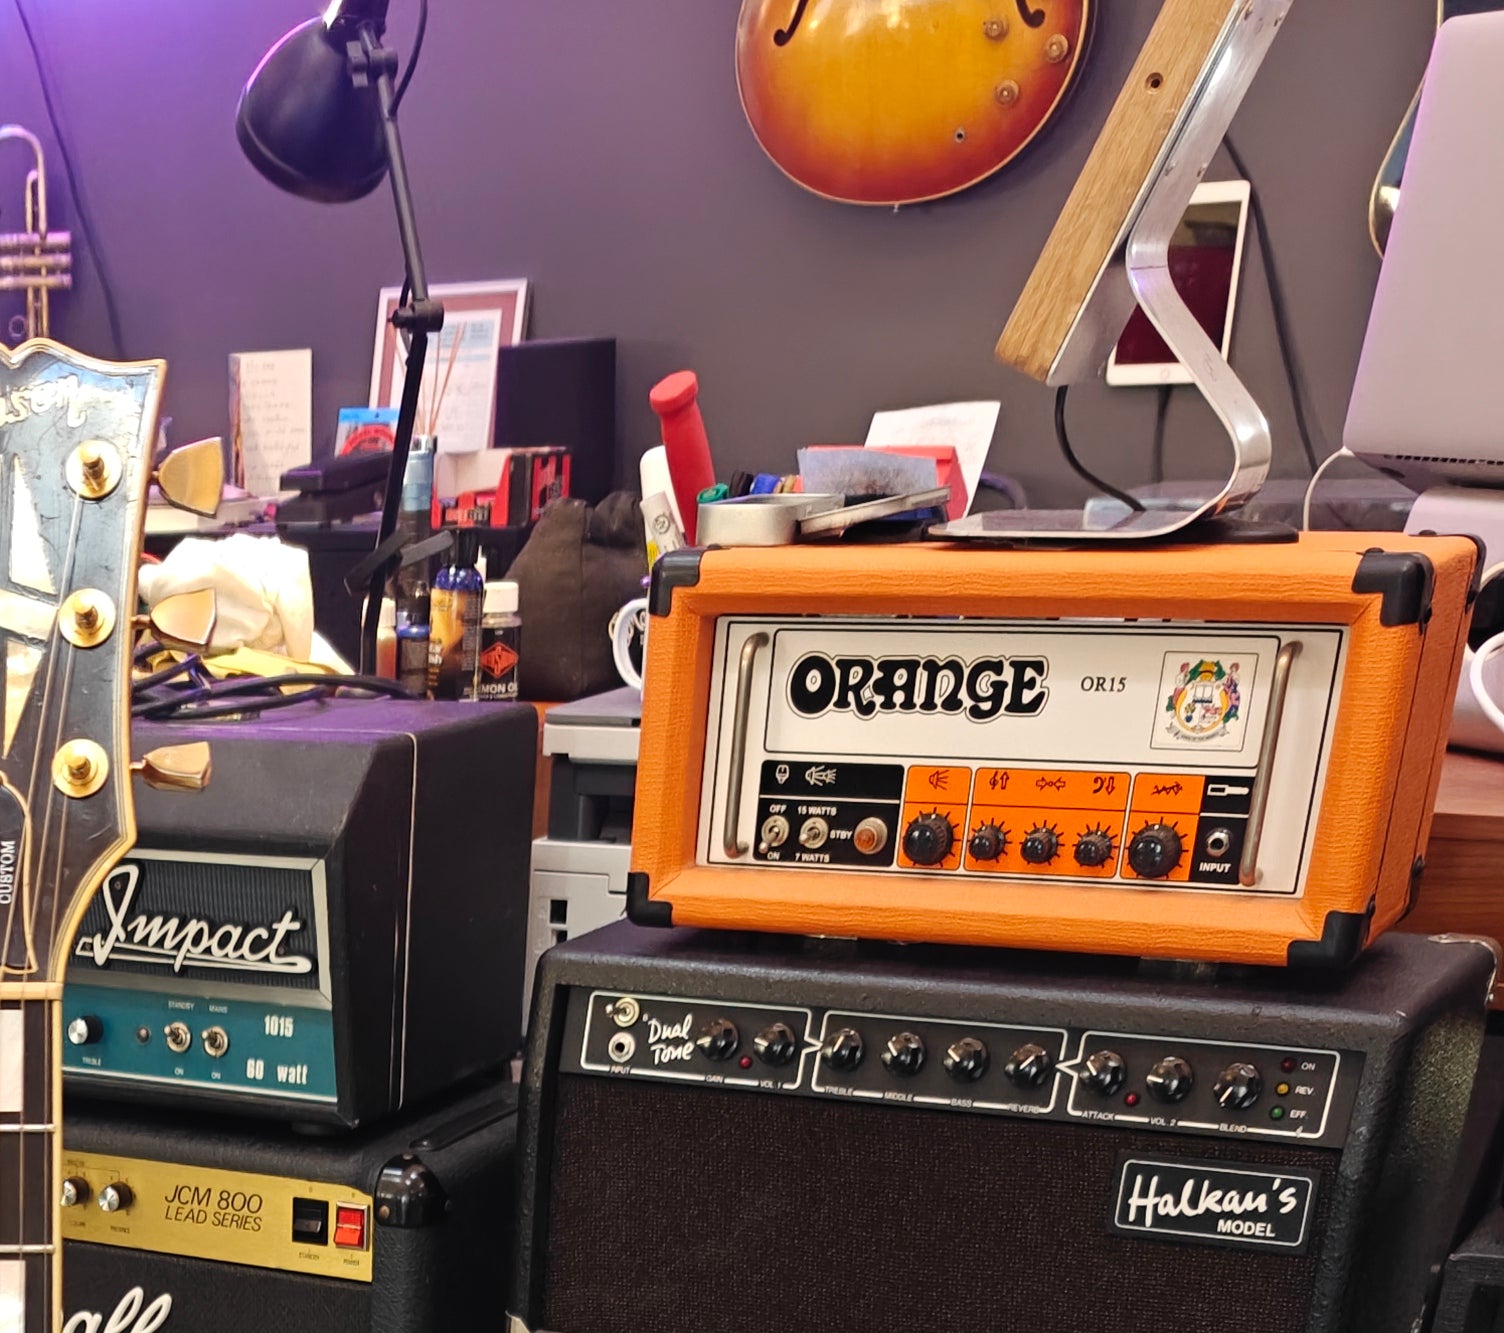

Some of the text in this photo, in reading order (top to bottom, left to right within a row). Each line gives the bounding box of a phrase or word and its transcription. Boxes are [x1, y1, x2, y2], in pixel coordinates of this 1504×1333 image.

[790, 655, 1048, 720] ORANGE
[1080, 676, 1127, 693] OR15
[769, 805, 787, 813] OFF
[797, 806, 837, 816] 15 WATTS
[830, 830, 853, 840] STBY
[767, 851, 780, 860] ON
[795, 853, 830, 863] 7 WATTS
[1199, 862, 1231, 873] INPUT
[76, 864, 312, 974] Impact
[168, 1000, 195, 1011] STANDBY
[264, 1015, 294, 1038] 1015
[648, 1013, 693, 1043] Dual
[650, 1043, 695, 1064] Tone
[175, 1067, 184, 1076] ON
[246, 1058, 308, 1085] 60 watt
[1300, 1062, 1316, 1071] ON
[211, 1072, 221, 1080] ON
[1081, 1111, 1114, 1121] ATTACK
[1219, 1123, 1247, 1134] BLEND
[165, 1185, 263, 1214] JCM 800
[165, 1206, 263, 1232] LEAD SERIES
[1217, 1219, 1276, 1237] MODEL
